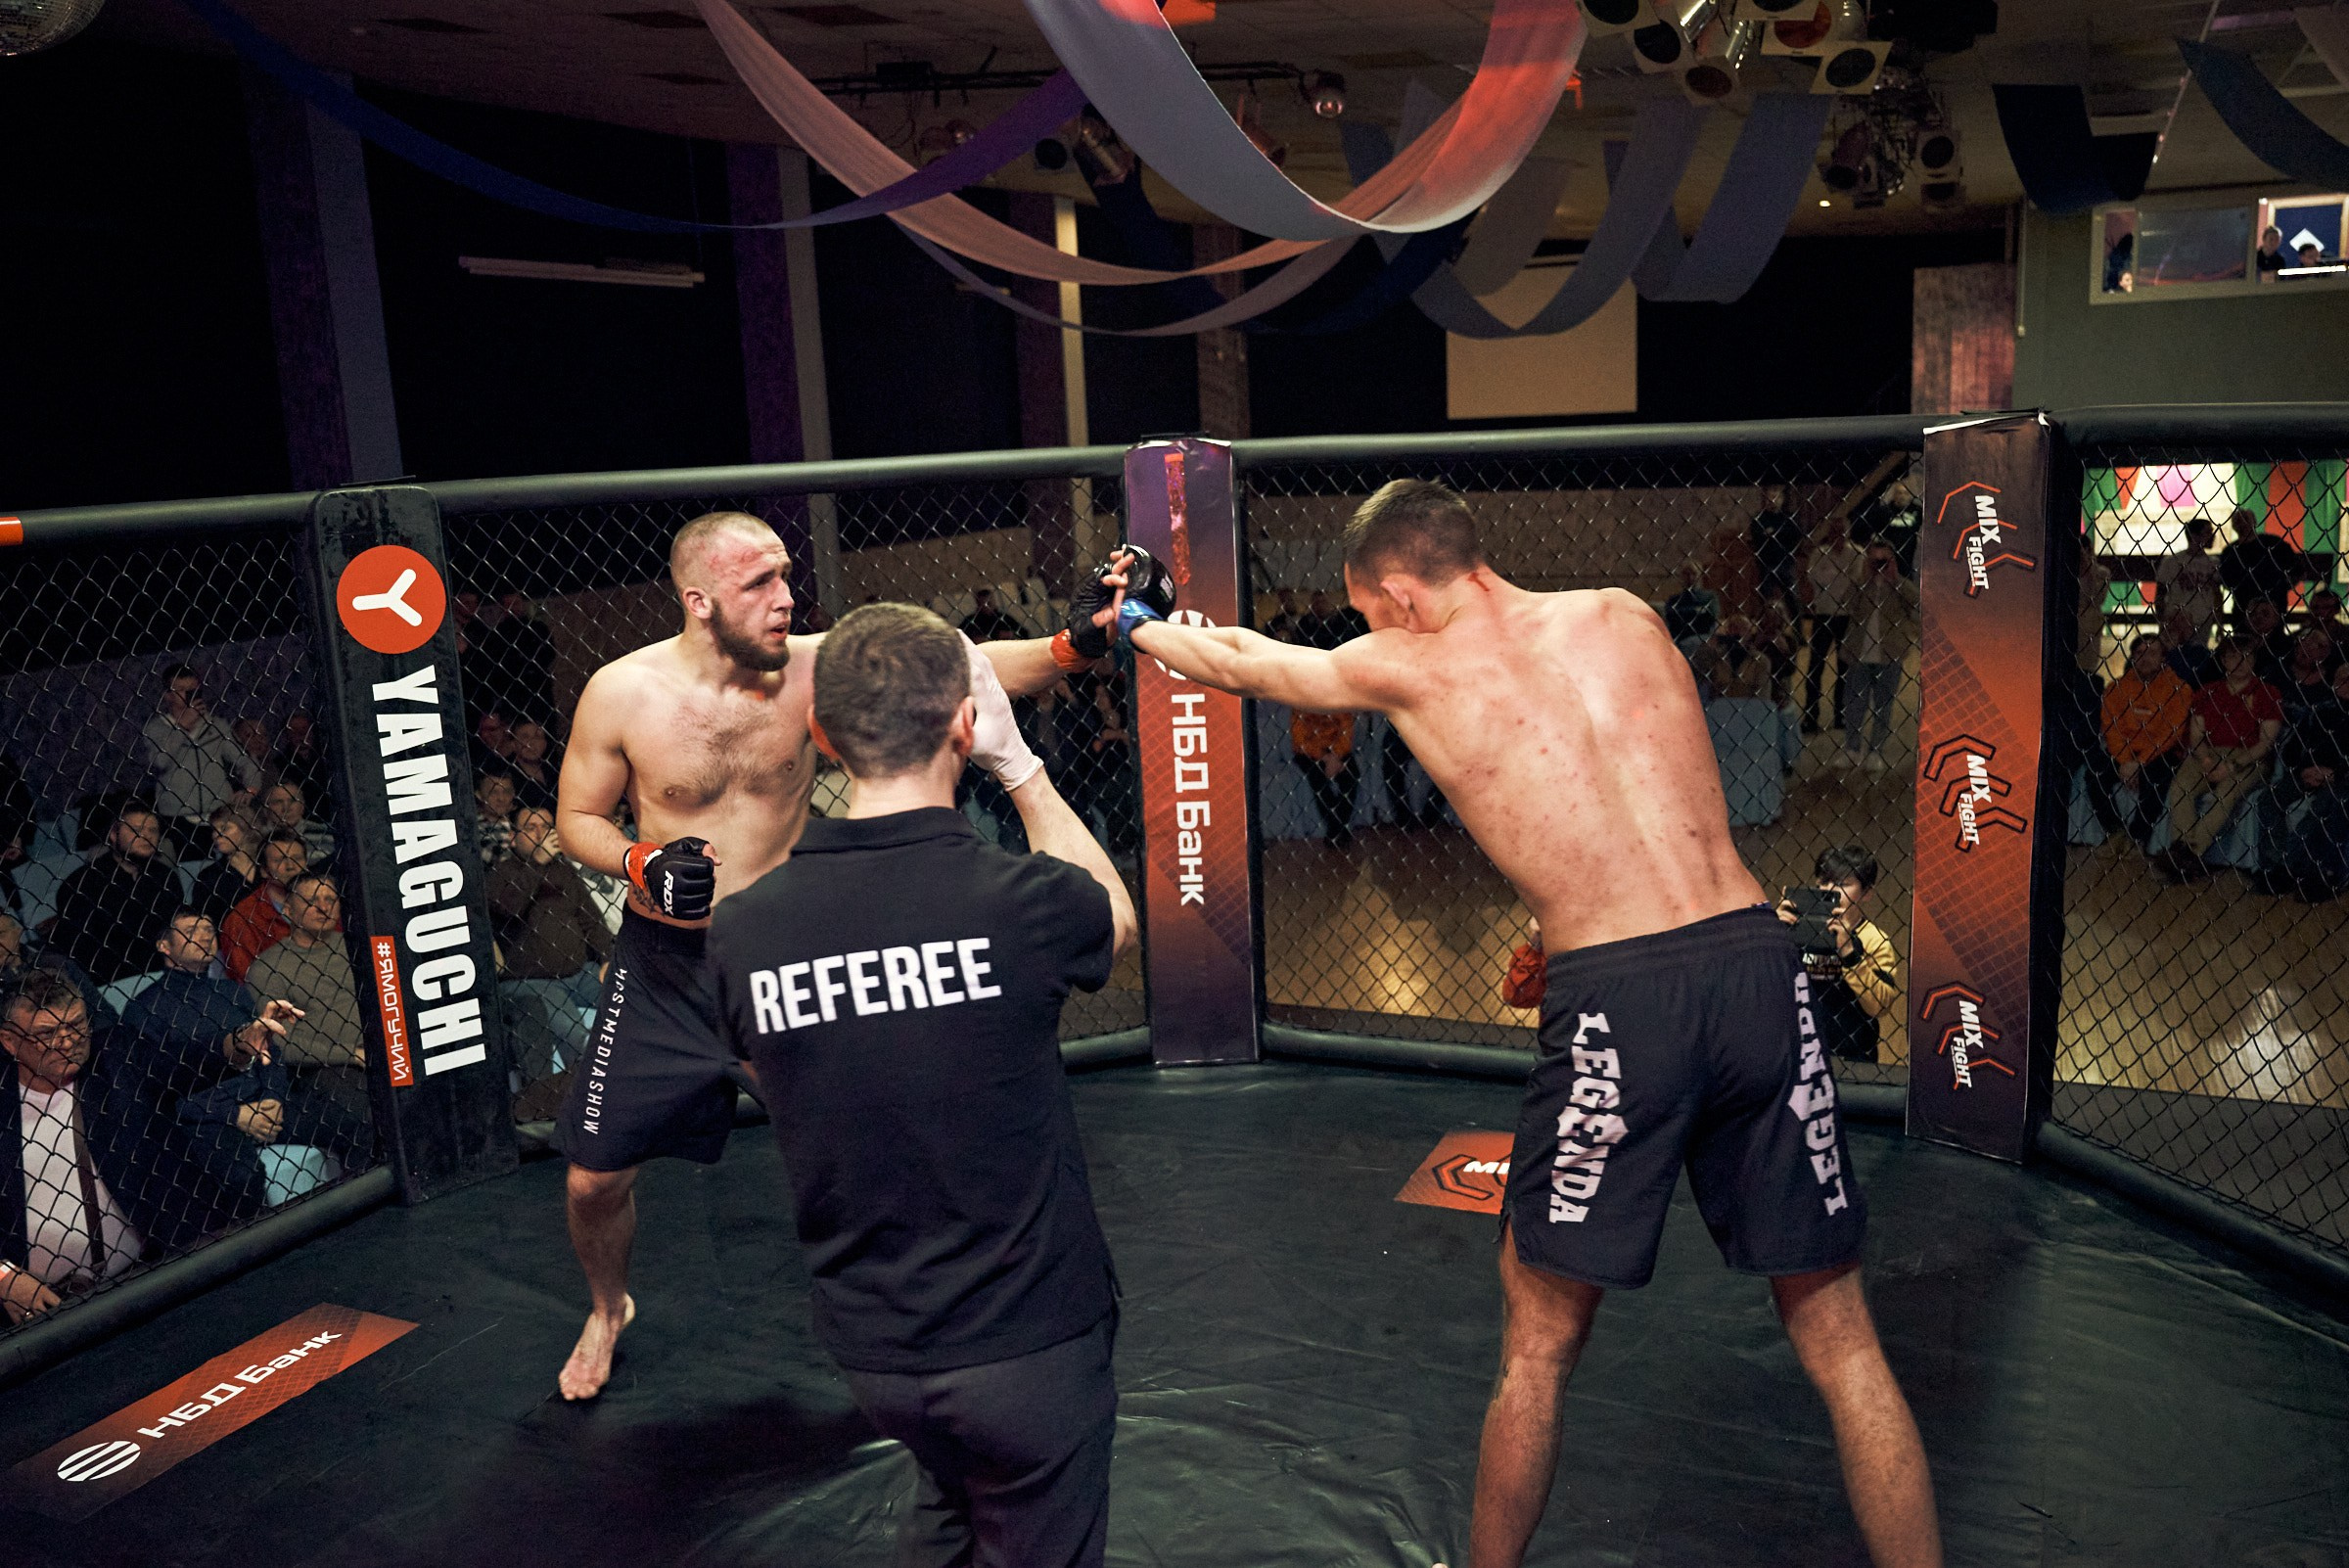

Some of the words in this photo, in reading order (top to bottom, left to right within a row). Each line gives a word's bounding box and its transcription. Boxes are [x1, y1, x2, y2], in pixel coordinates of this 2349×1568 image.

[1975, 495, 2002, 544] MIX
[1969, 536, 1990, 589] FIGHT
[1172, 693, 1210, 793] НБД
[1966, 755, 1992, 803] MIX
[1960, 793, 1980, 845] FIGHT
[372, 665, 486, 1076] YAMAGUCHI
[1175, 801, 1211, 906] Банк
[664, 870, 674, 916] RDX
[750, 938, 1001, 1035] REFEREE
[1958, 1000, 1984, 1048] MIX
[1953, 1037, 1972, 1087] FIGHT
[1549, 1012, 1629, 1223] LEGENDA
[1463, 1161, 1510, 1174] MI
[137, 1383, 247, 1439] НБД
[235, 1330, 343, 1384] Банк
